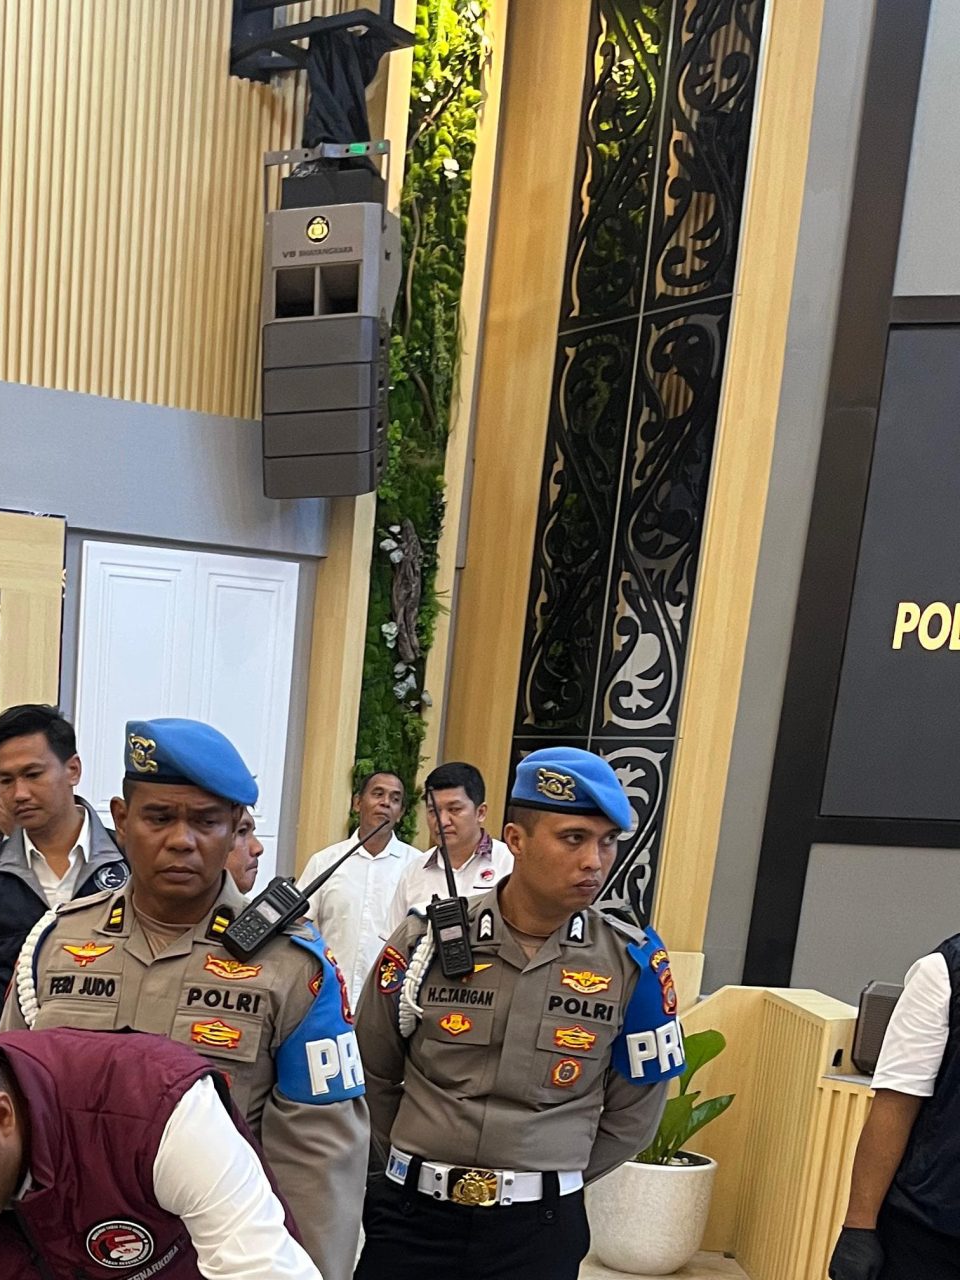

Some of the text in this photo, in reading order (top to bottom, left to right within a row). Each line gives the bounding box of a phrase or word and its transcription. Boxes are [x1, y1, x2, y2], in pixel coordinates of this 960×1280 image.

[78, 976, 116, 998] JUDO
[187, 987, 261, 1014] POLRI
[548, 995, 614, 1022] POLRI
